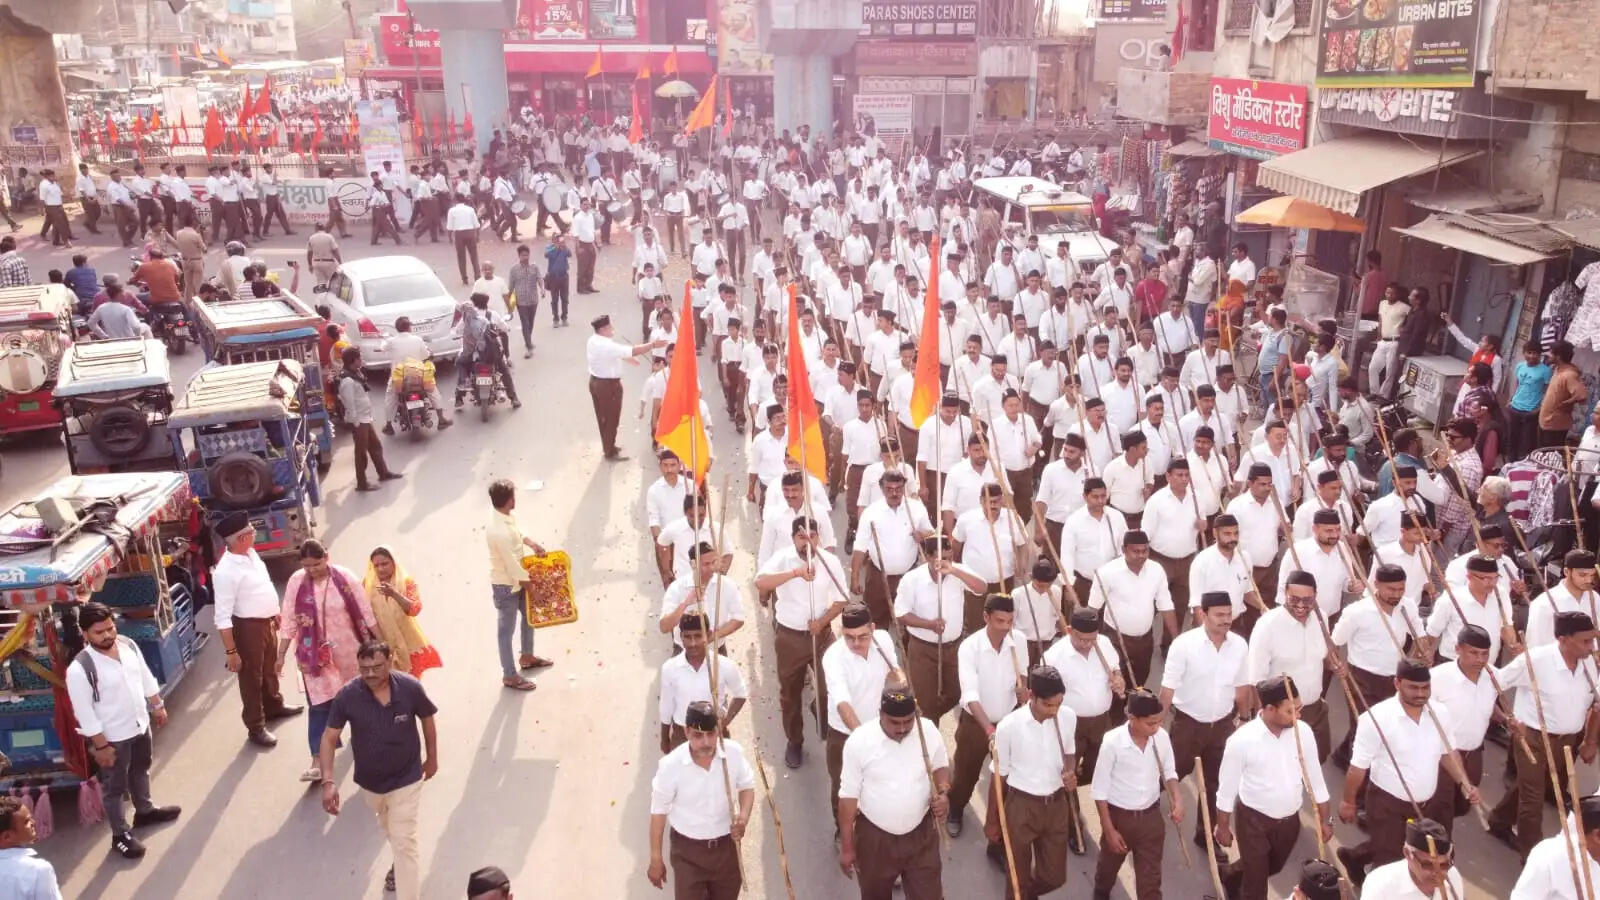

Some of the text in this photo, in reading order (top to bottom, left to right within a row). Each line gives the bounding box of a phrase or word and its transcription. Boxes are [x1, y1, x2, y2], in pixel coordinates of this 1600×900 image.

[544, 10, 573, 21] 15%
[863, 4, 977, 20] PARAS SHOES CENTER
[1398, 0, 1473, 22] URBAN BITES
[1232, 87, 1273, 125] मेडिकल
[1274, 93, 1303, 130] स्टोर
